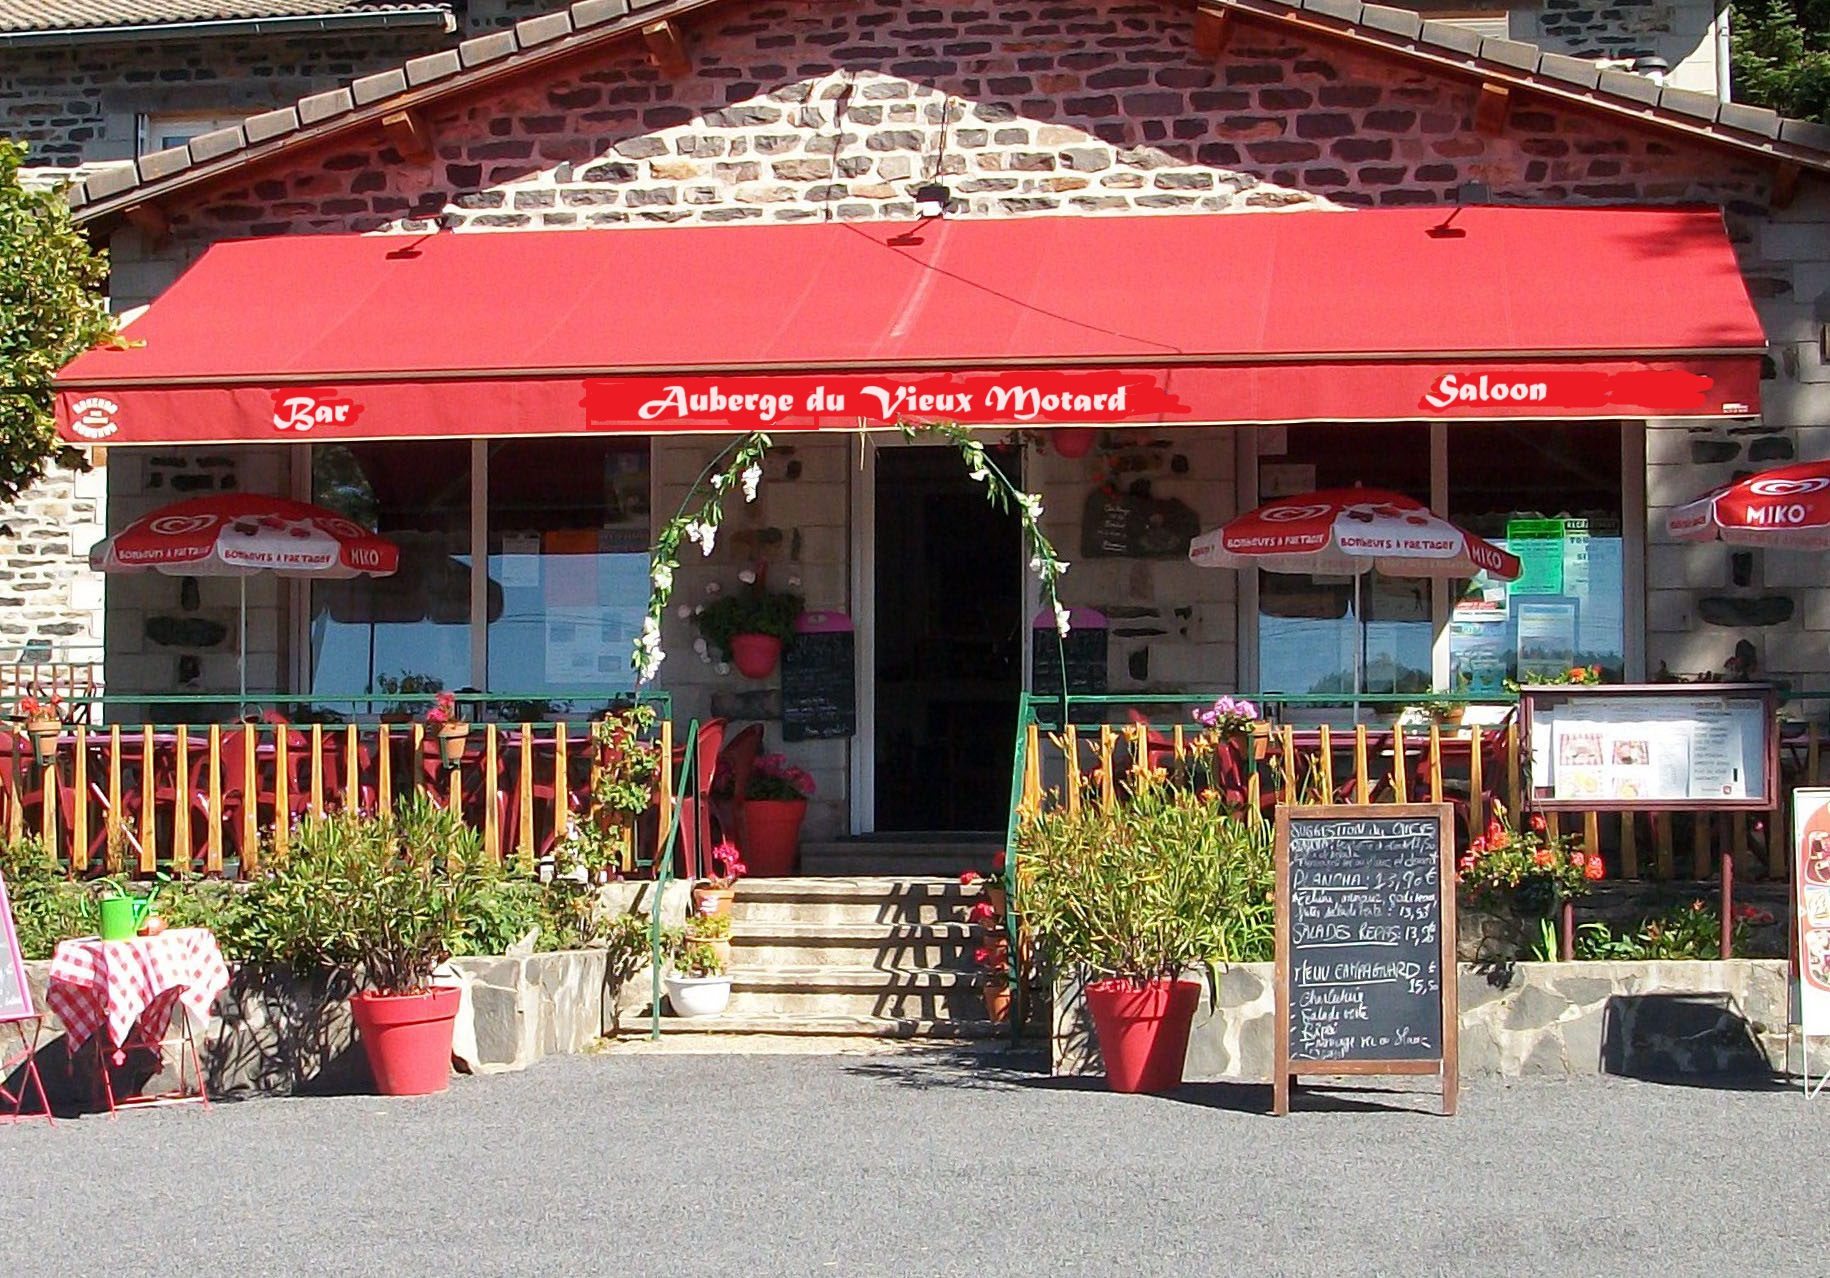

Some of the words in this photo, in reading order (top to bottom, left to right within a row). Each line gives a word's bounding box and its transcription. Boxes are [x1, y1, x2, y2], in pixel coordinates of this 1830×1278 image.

[638, 385, 794, 423] Auberge
[806, 385, 845, 411] du
[859, 385, 973, 418] Vieux
[985, 385, 1127, 420] Motard
[1424, 374, 1548, 408] Saloon
[273, 396, 350, 431] Bar
[1746, 504, 1806, 525] MIKO
[351, 548, 380, 566] MIKO
[1471, 545, 1502, 569] MIKO
